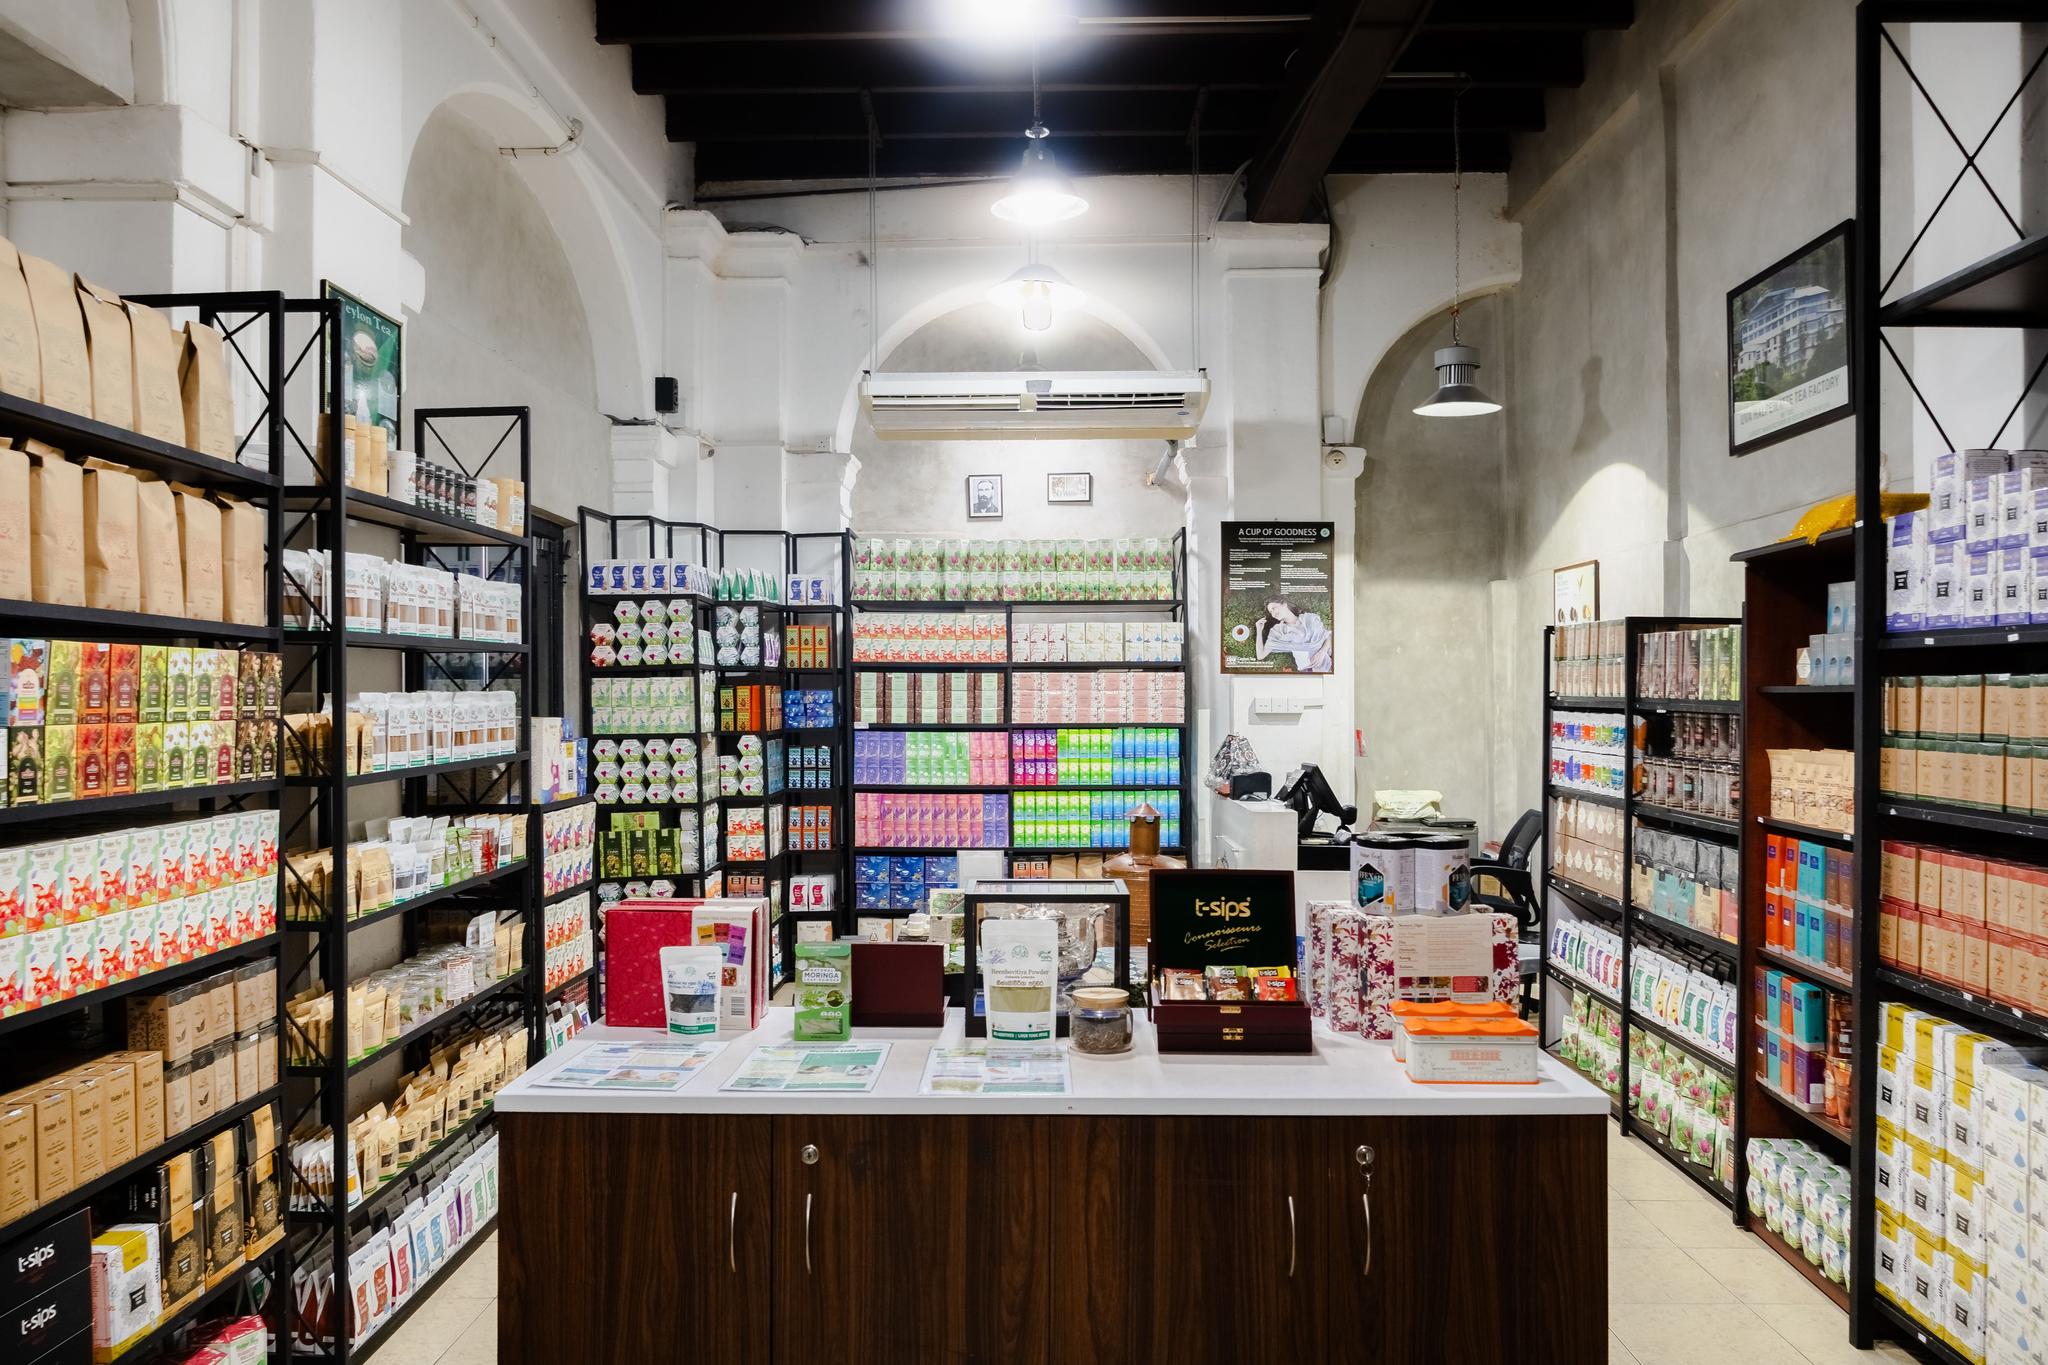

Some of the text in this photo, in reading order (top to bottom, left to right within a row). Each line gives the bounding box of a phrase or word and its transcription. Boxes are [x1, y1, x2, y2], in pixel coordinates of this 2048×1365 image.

[1795, 387, 1807, 403] TEA
[1808, 374, 1840, 398] FACTORY
[1239, 528, 1317, 536] A CUP OF GOODNESS
[1195, 896, 1252, 921] t-sips
[1184, 925, 1263, 945] Connoisseurs
[1204, 936, 1250, 951] Selection
[18, 1241, 55, 1273] t-sips
[21, 1304, 57, 1335] t-sips
